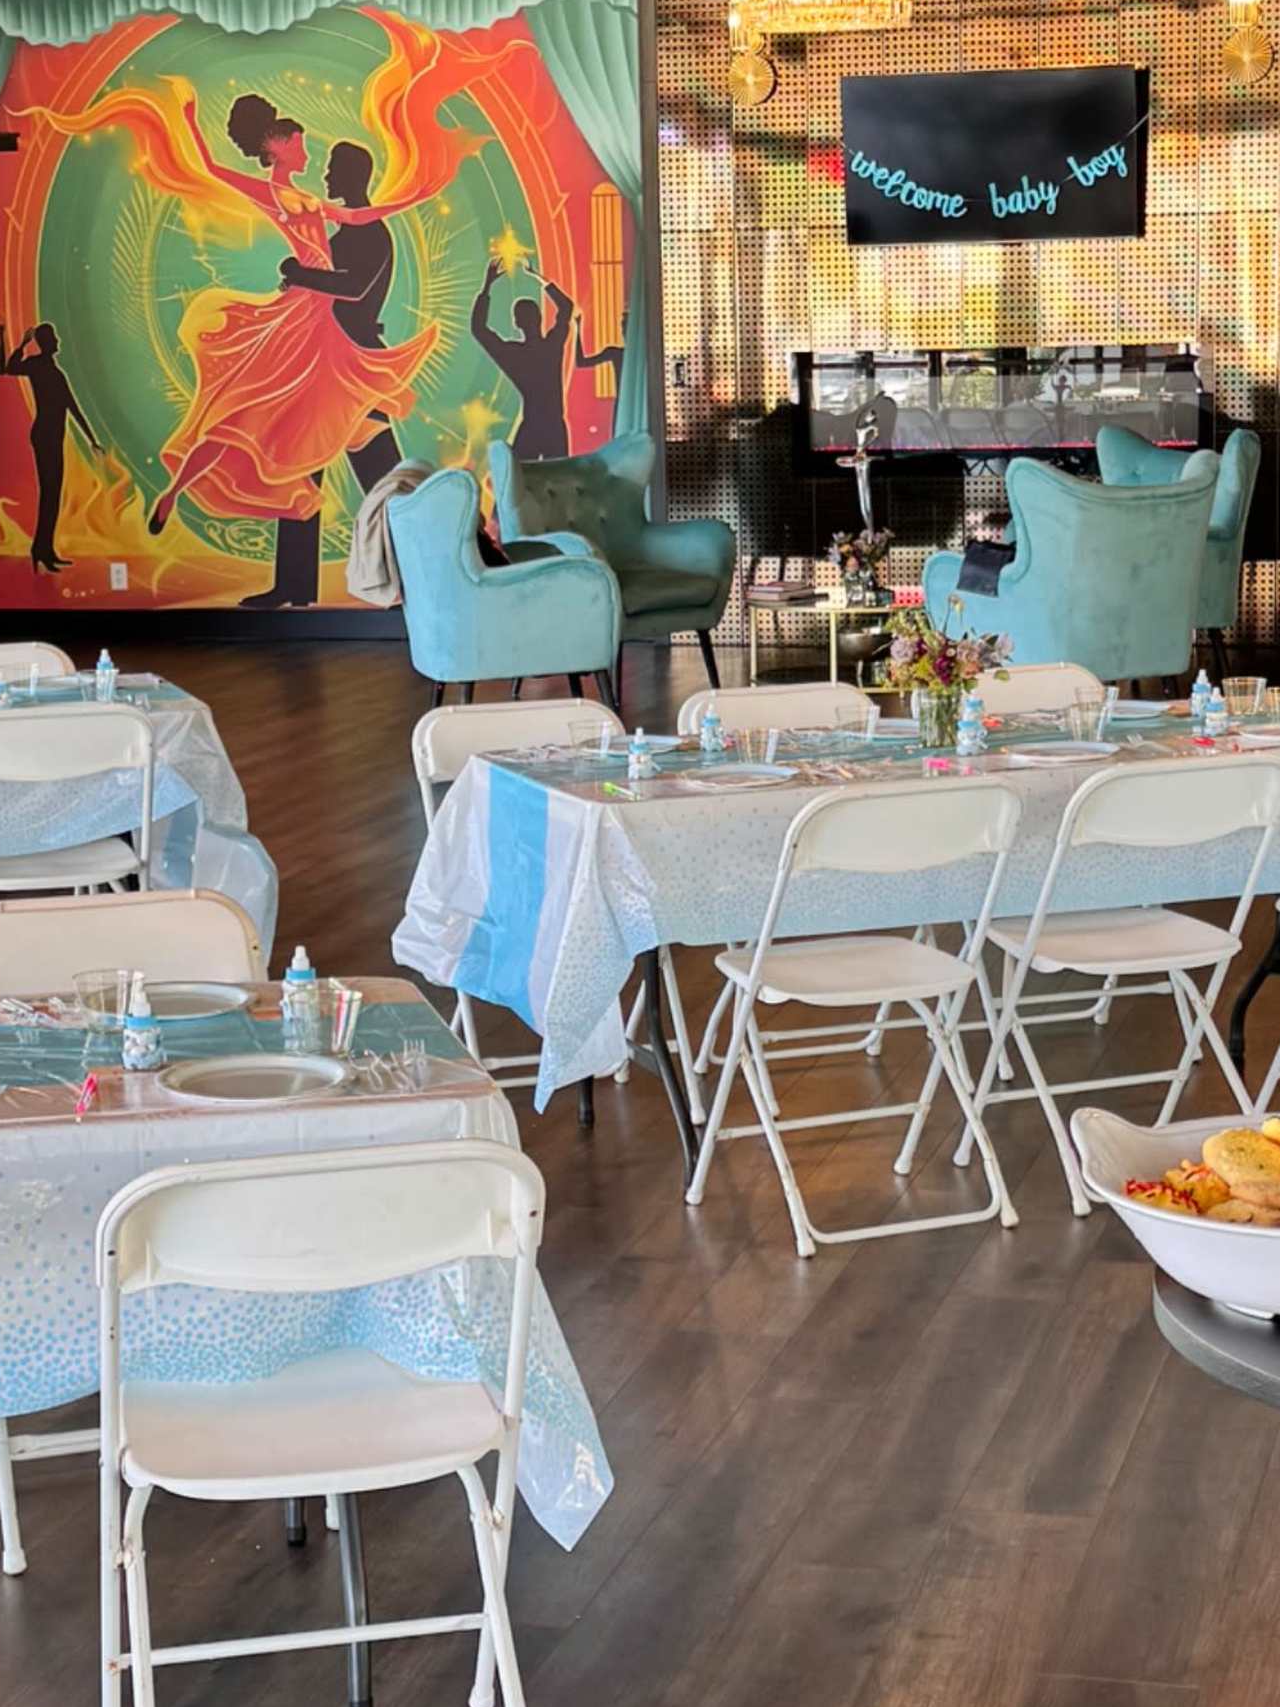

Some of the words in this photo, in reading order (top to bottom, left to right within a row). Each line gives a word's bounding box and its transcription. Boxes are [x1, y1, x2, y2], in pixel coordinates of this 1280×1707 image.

[850, 149, 968, 218] welcome
[988, 175, 1060, 219] baby
[1066, 142, 1126, 188] boy
